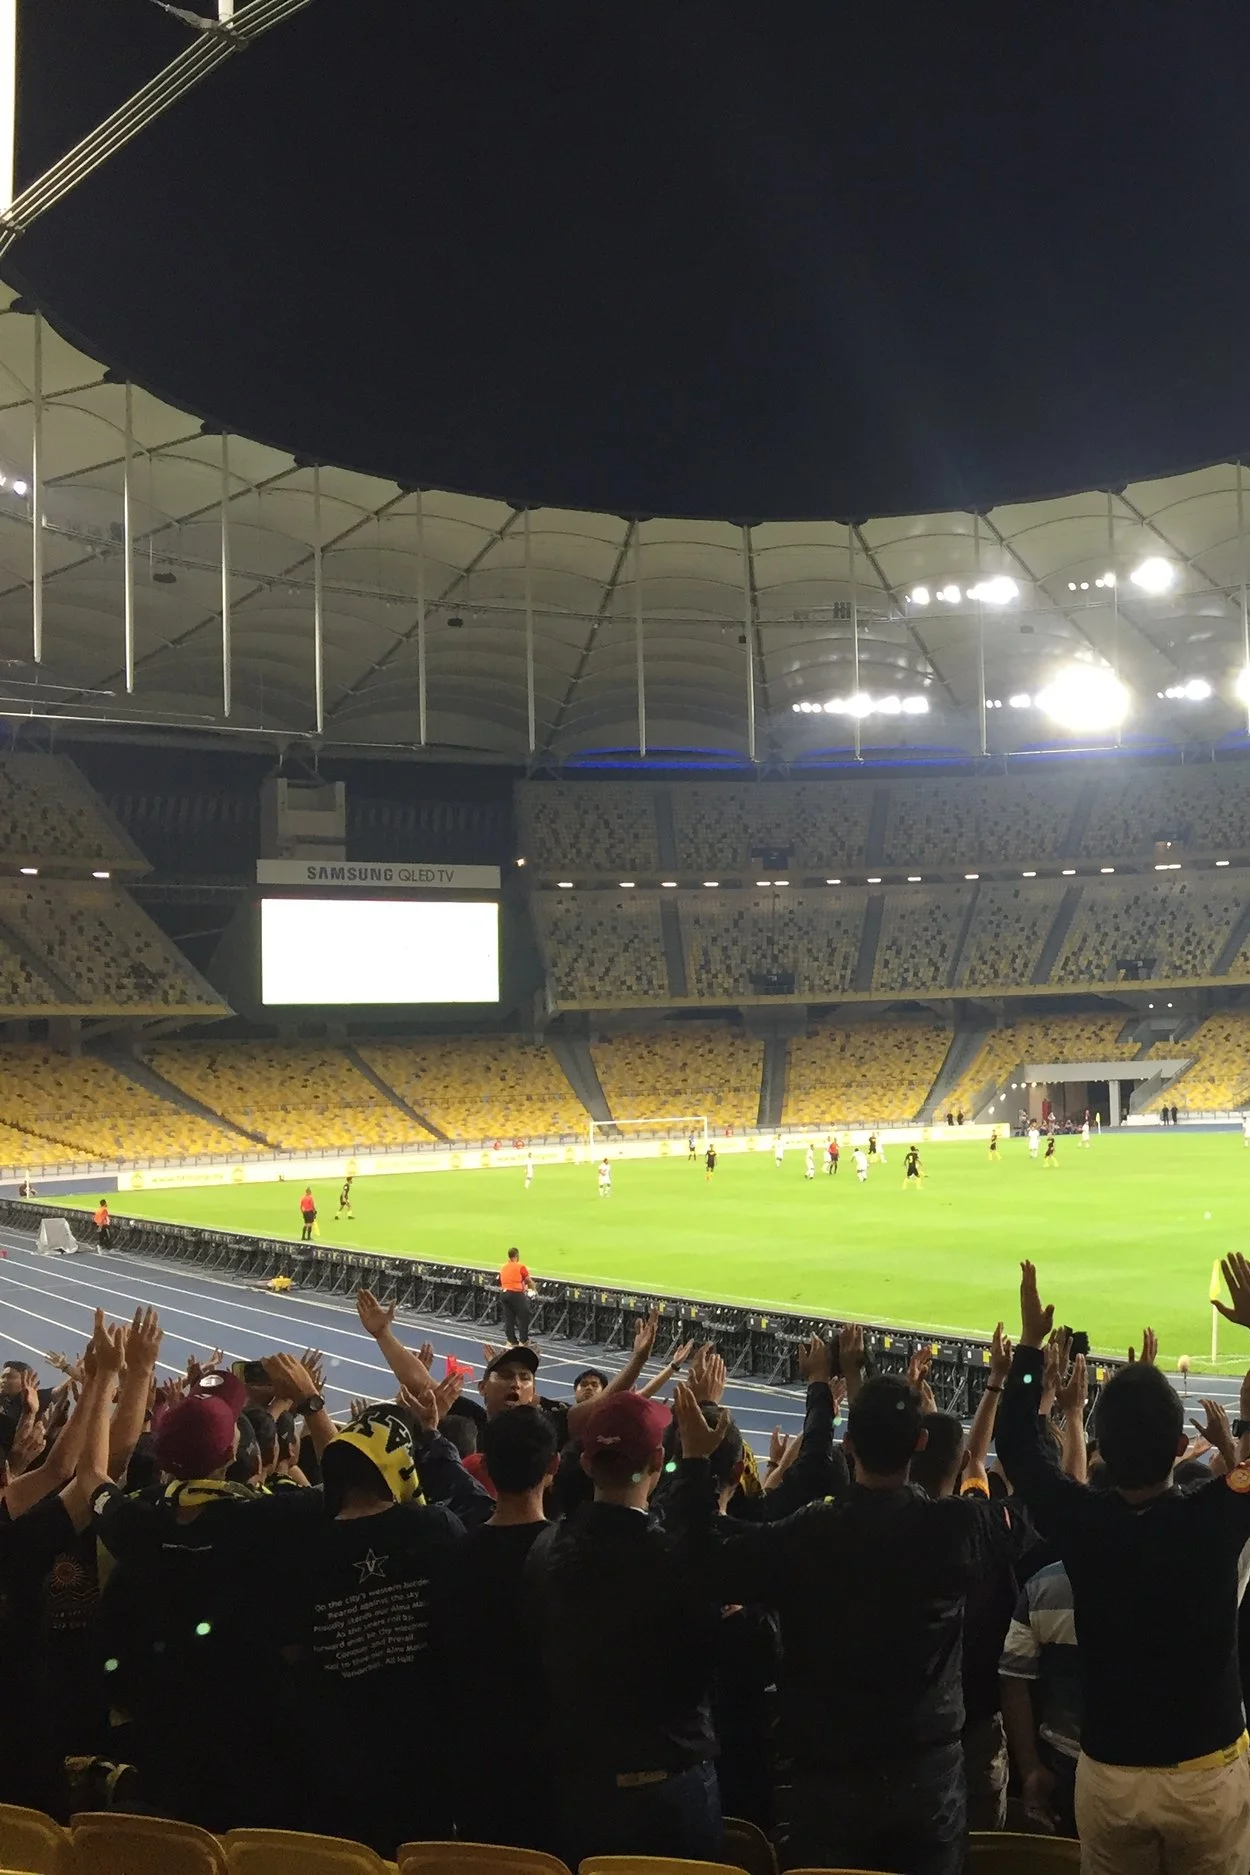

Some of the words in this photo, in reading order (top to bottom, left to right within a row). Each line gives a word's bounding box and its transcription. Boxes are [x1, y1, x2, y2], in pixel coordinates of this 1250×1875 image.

[307, 866, 393, 881] SAMSUNG
[398, 868, 435, 882] QLED
[437, 870, 454, 882] TV
[367, 1560, 376, 1572] V
